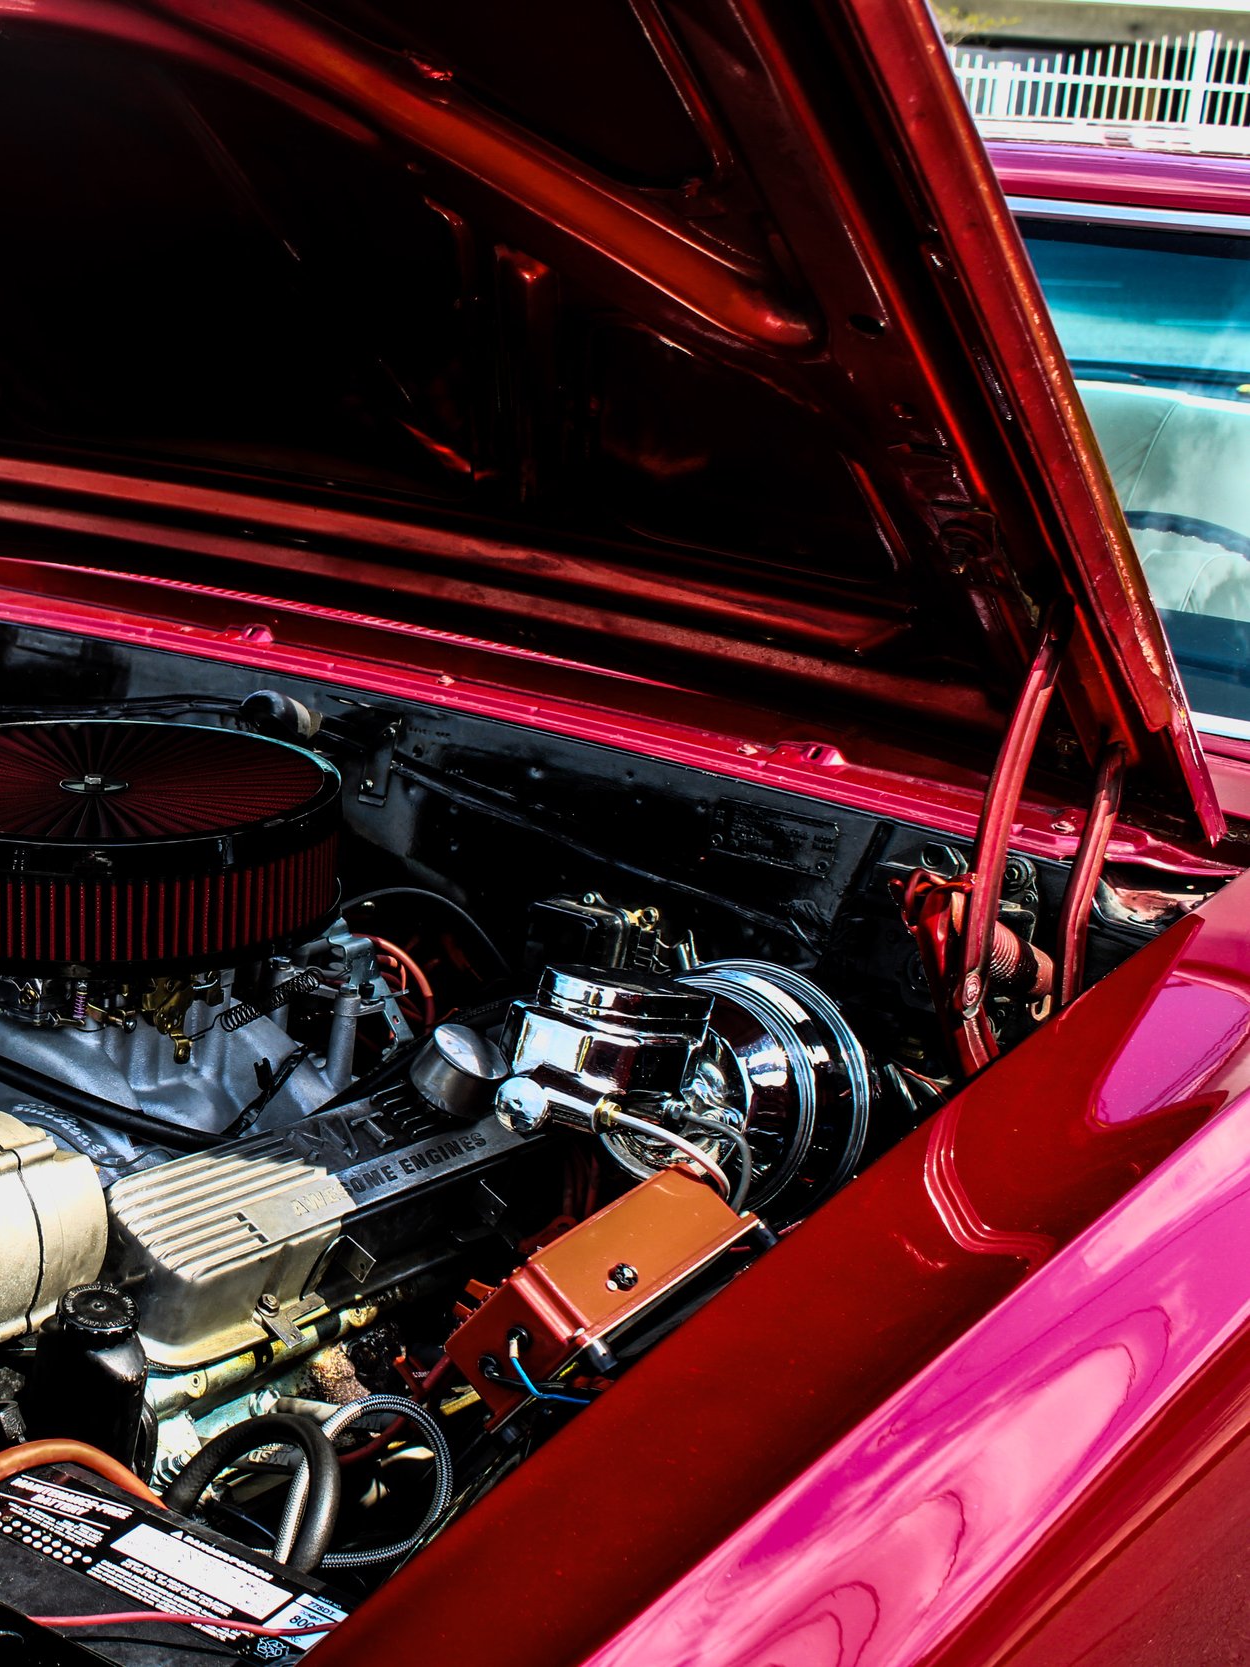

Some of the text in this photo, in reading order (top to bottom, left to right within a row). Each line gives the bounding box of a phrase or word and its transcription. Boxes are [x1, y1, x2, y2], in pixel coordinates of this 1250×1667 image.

[290, 1132, 487, 1217] AWESOME ENGINES
[247, 1449, 290, 1467] MSD
[10, 1477, 133, 1520] MAINTENANCE-FREE
[30, 1494, 90, 1516] BATTERY
